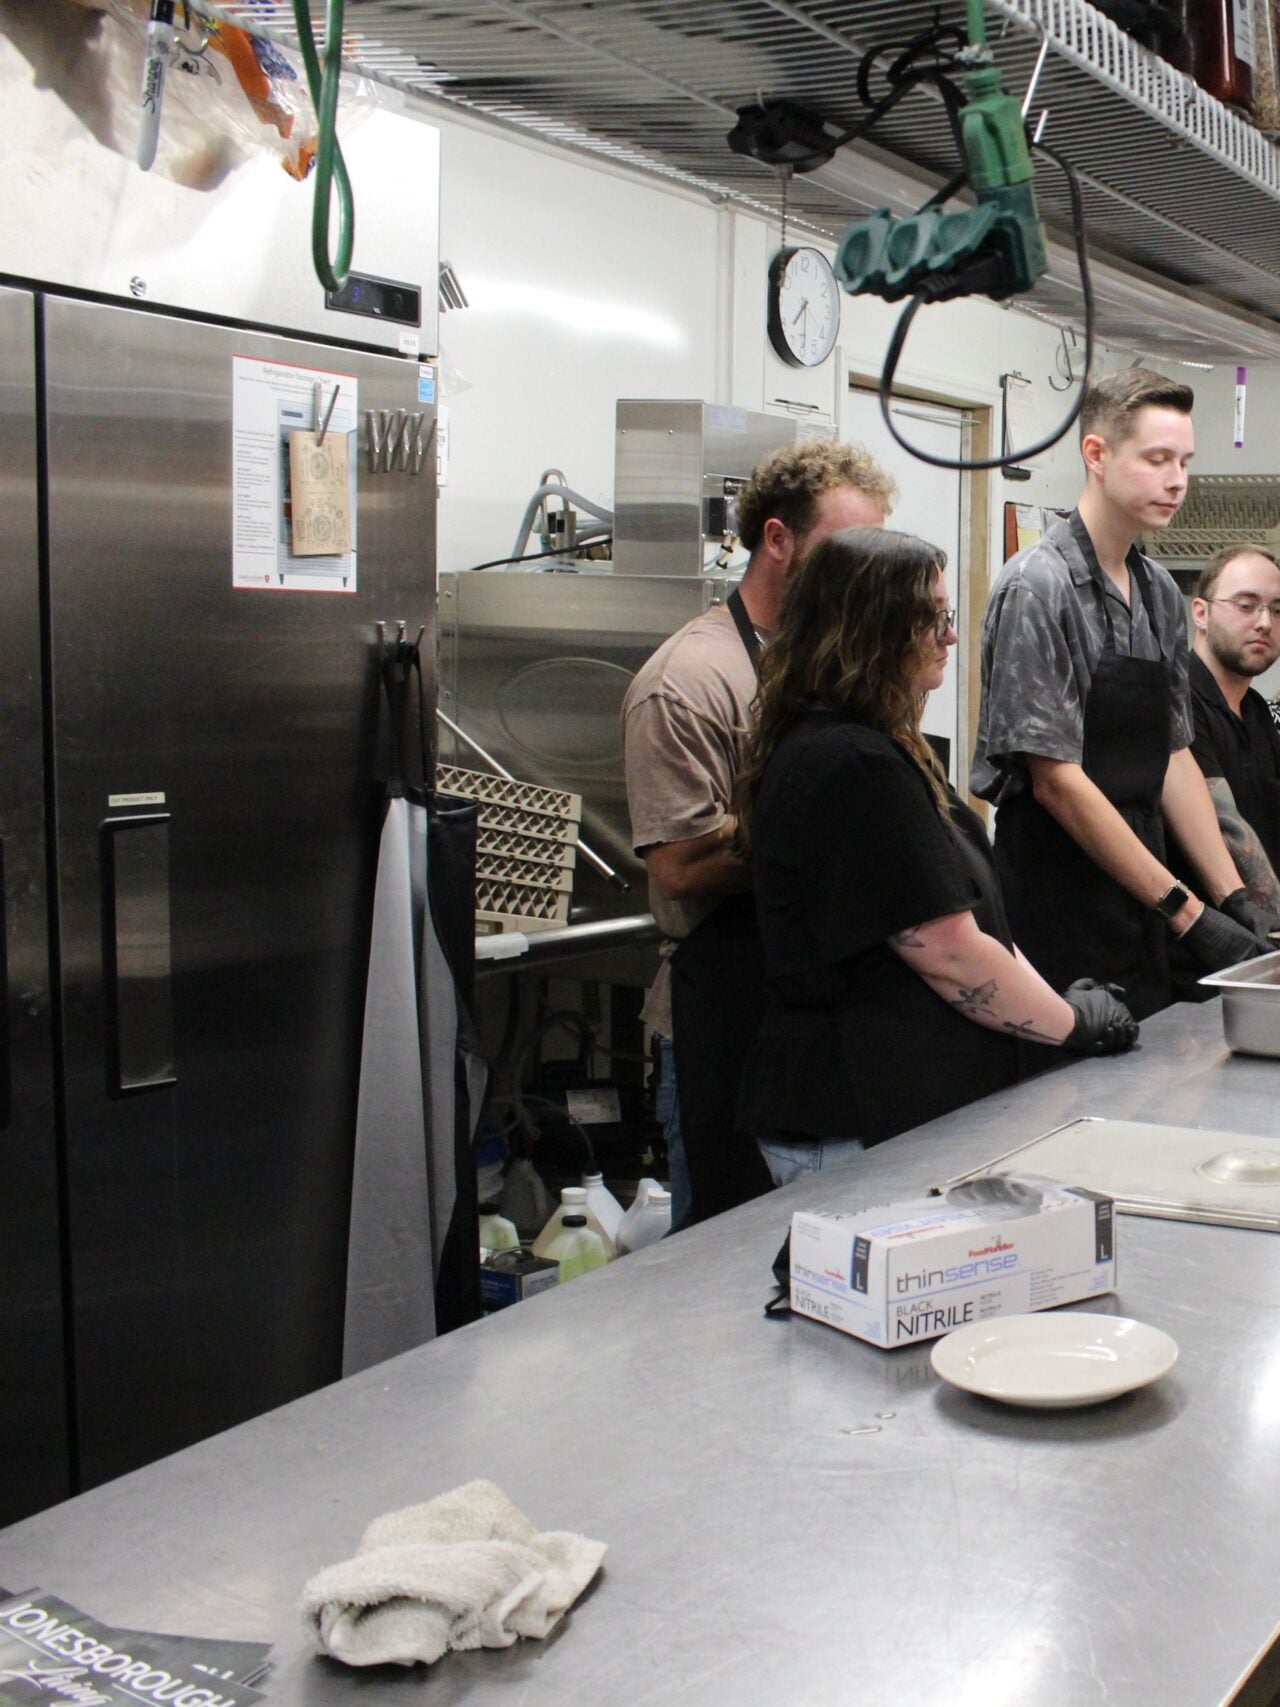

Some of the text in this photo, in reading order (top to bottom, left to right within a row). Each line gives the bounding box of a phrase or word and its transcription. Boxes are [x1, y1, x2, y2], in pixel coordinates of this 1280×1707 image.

[801, 256, 809, 272] 12
[820, 282, 827, 298] 2
[968, 1242, 1015, 1259] FoodHandler
[1100, 1243, 1109, 1260] L
[856, 1272, 864, 1290] L
[896, 1253, 1019, 1293] thinsense
[795, 1294, 830, 1319] NITRILE
[896, 1300, 934, 1318] BLACK
[896, 1301, 974, 1340] NITRILE
[0, 1601, 237, 1707] JONESBOROUGH
